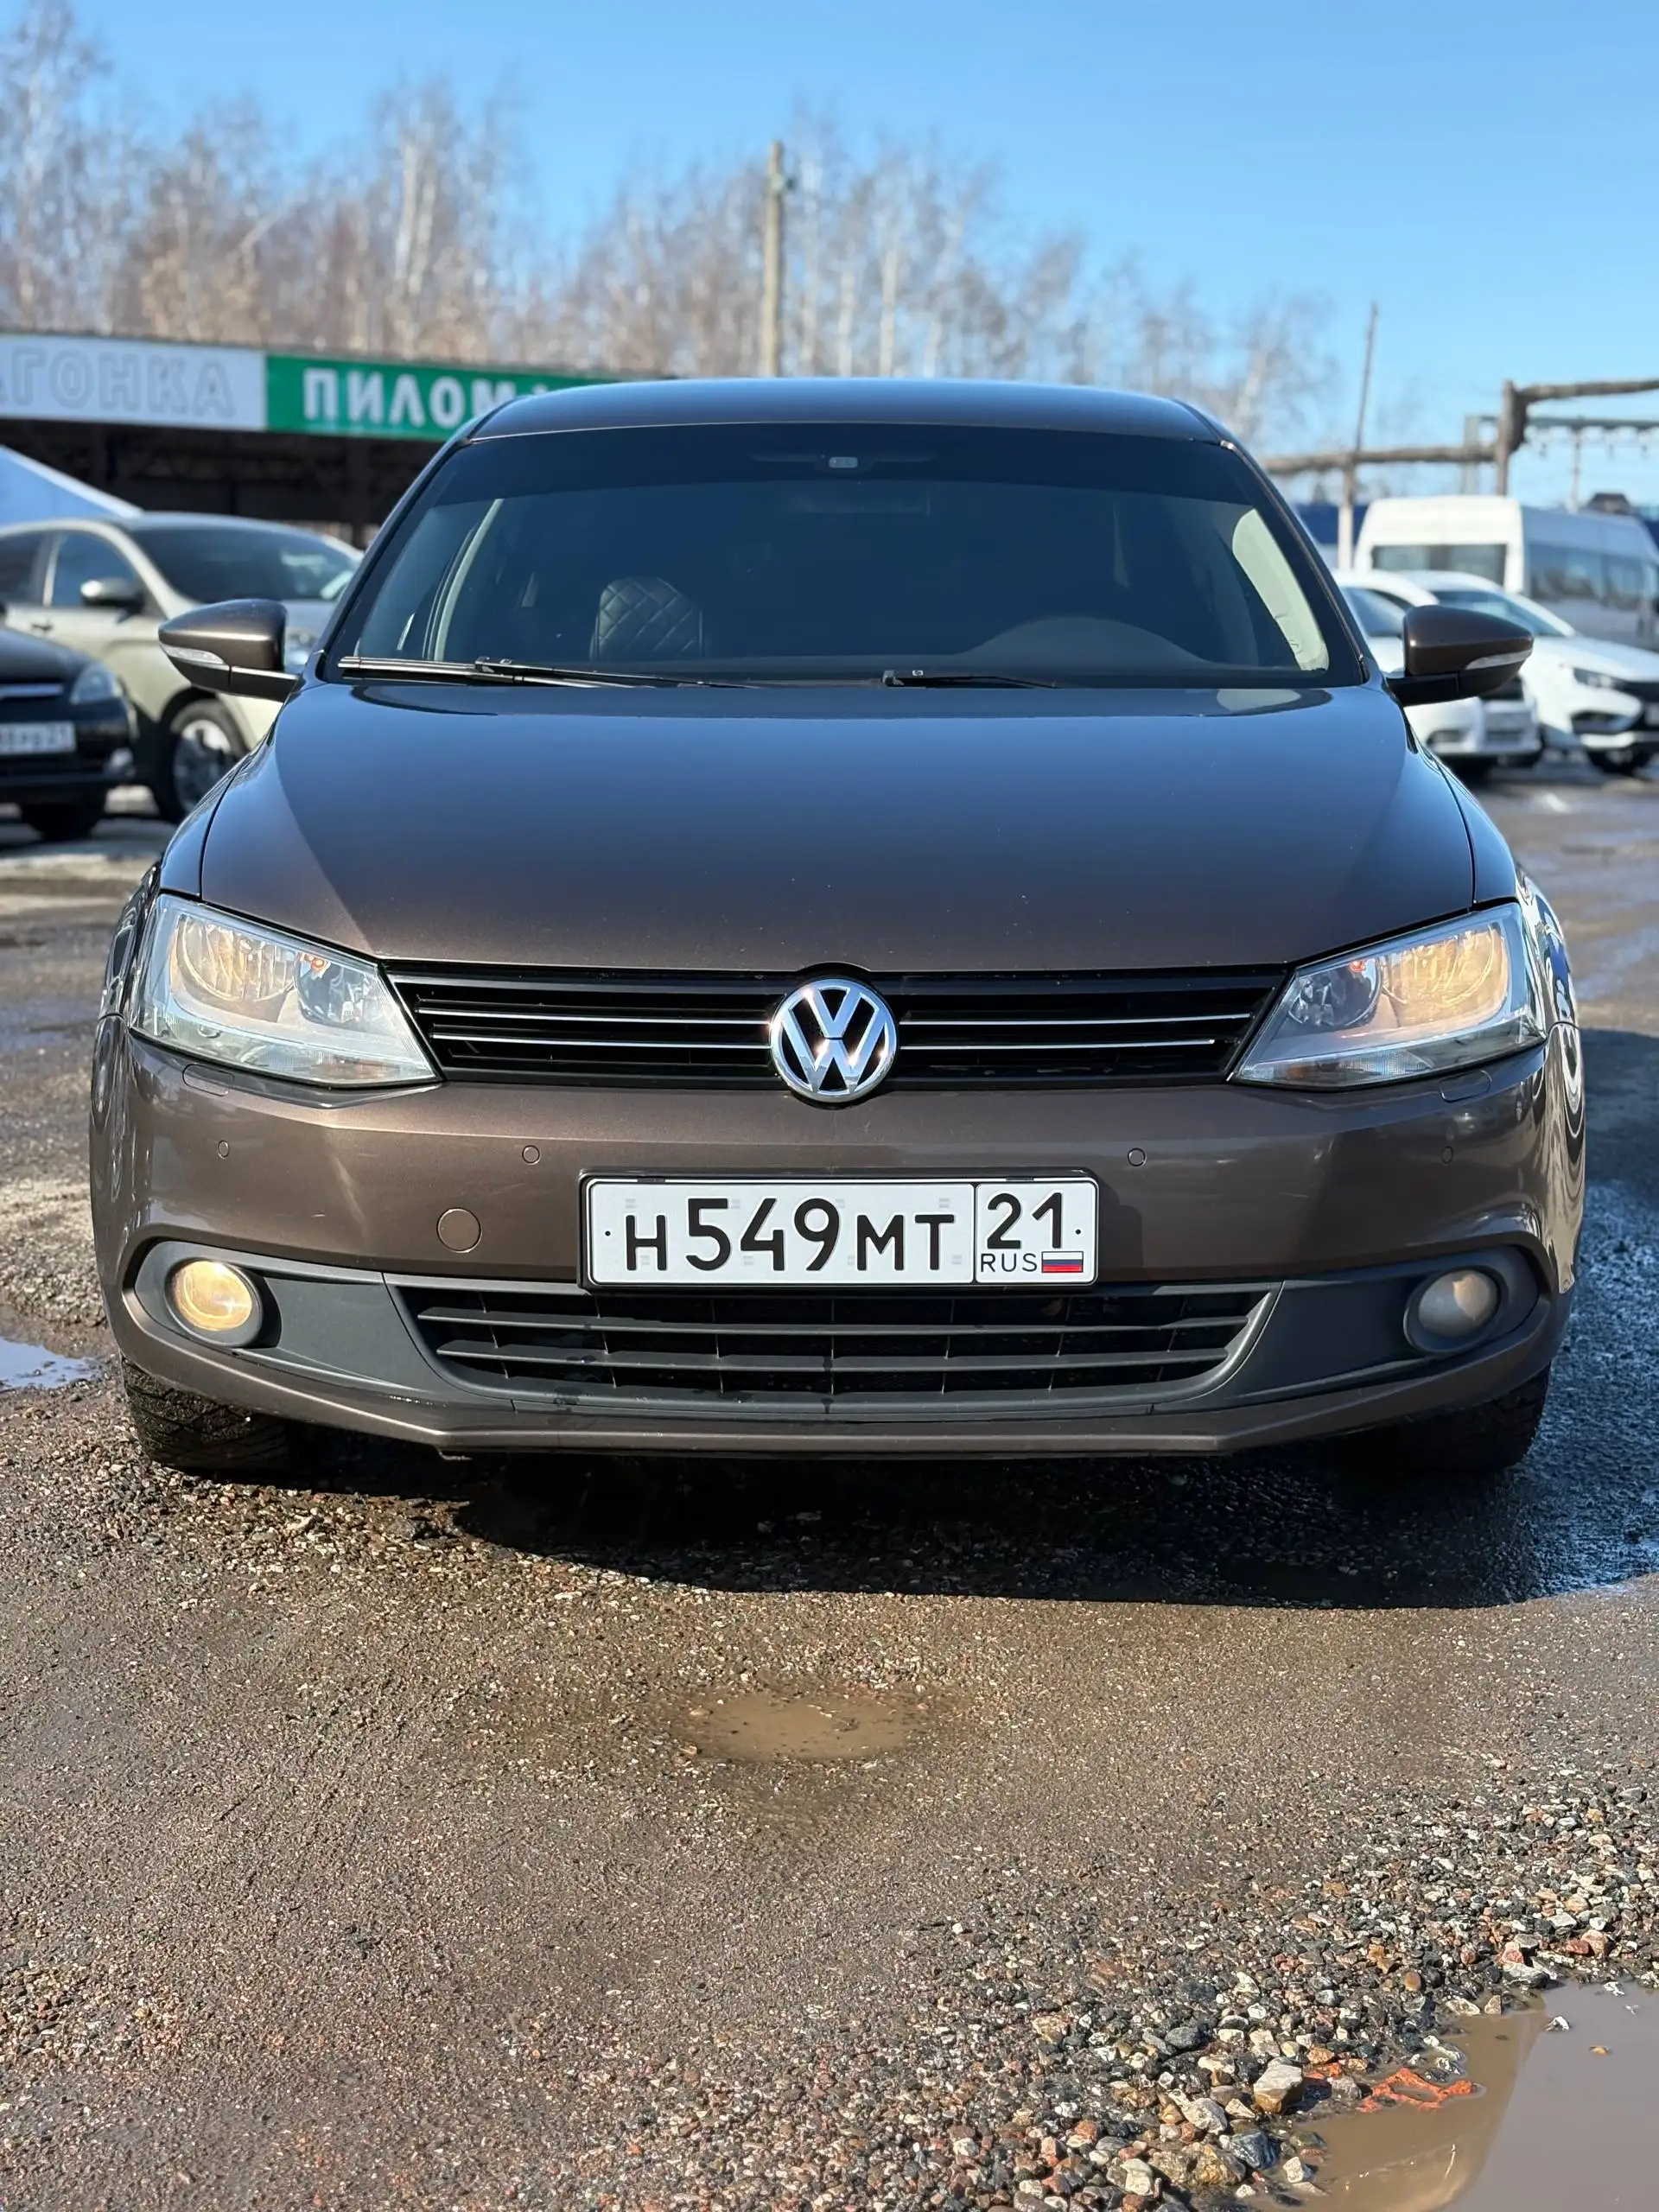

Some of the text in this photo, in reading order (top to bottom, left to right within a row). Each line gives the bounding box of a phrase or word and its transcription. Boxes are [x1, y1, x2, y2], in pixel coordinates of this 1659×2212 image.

[0, 346, 237, 418] ГОНКА
[302, 367, 550, 428] ПИЛОМ
[987, 1192, 1063, 1249] 21
[980, 1253, 1038, 1273] RUS
